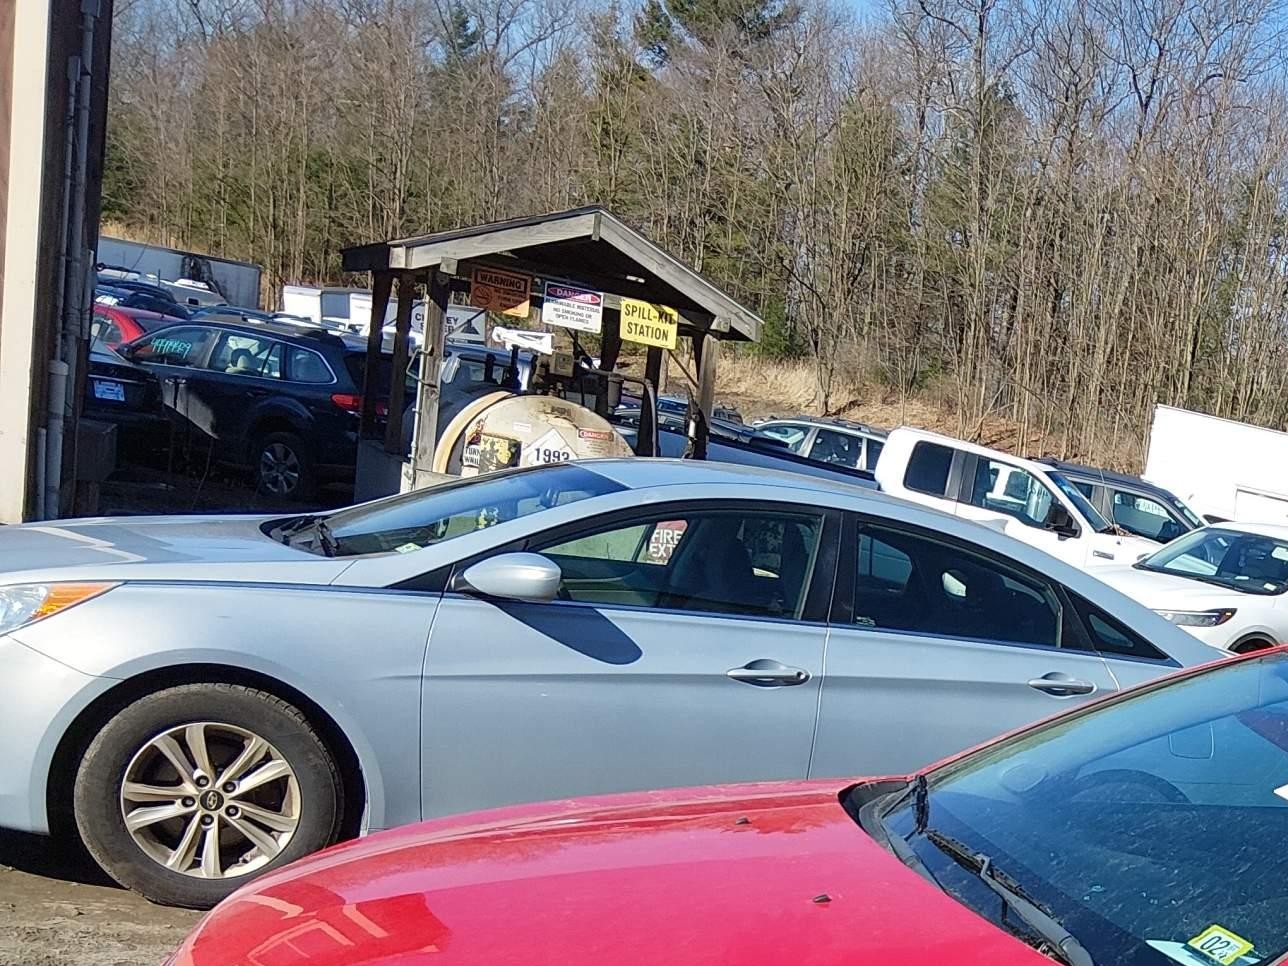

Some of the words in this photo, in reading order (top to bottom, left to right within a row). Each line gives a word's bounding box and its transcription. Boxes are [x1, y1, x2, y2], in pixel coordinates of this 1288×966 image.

[480, 272, 522, 290] WARNING
[626, 321, 669, 342] STATION
[651, 529, 684, 545] FIRE
[1200, 935, 1231, 956] 02
